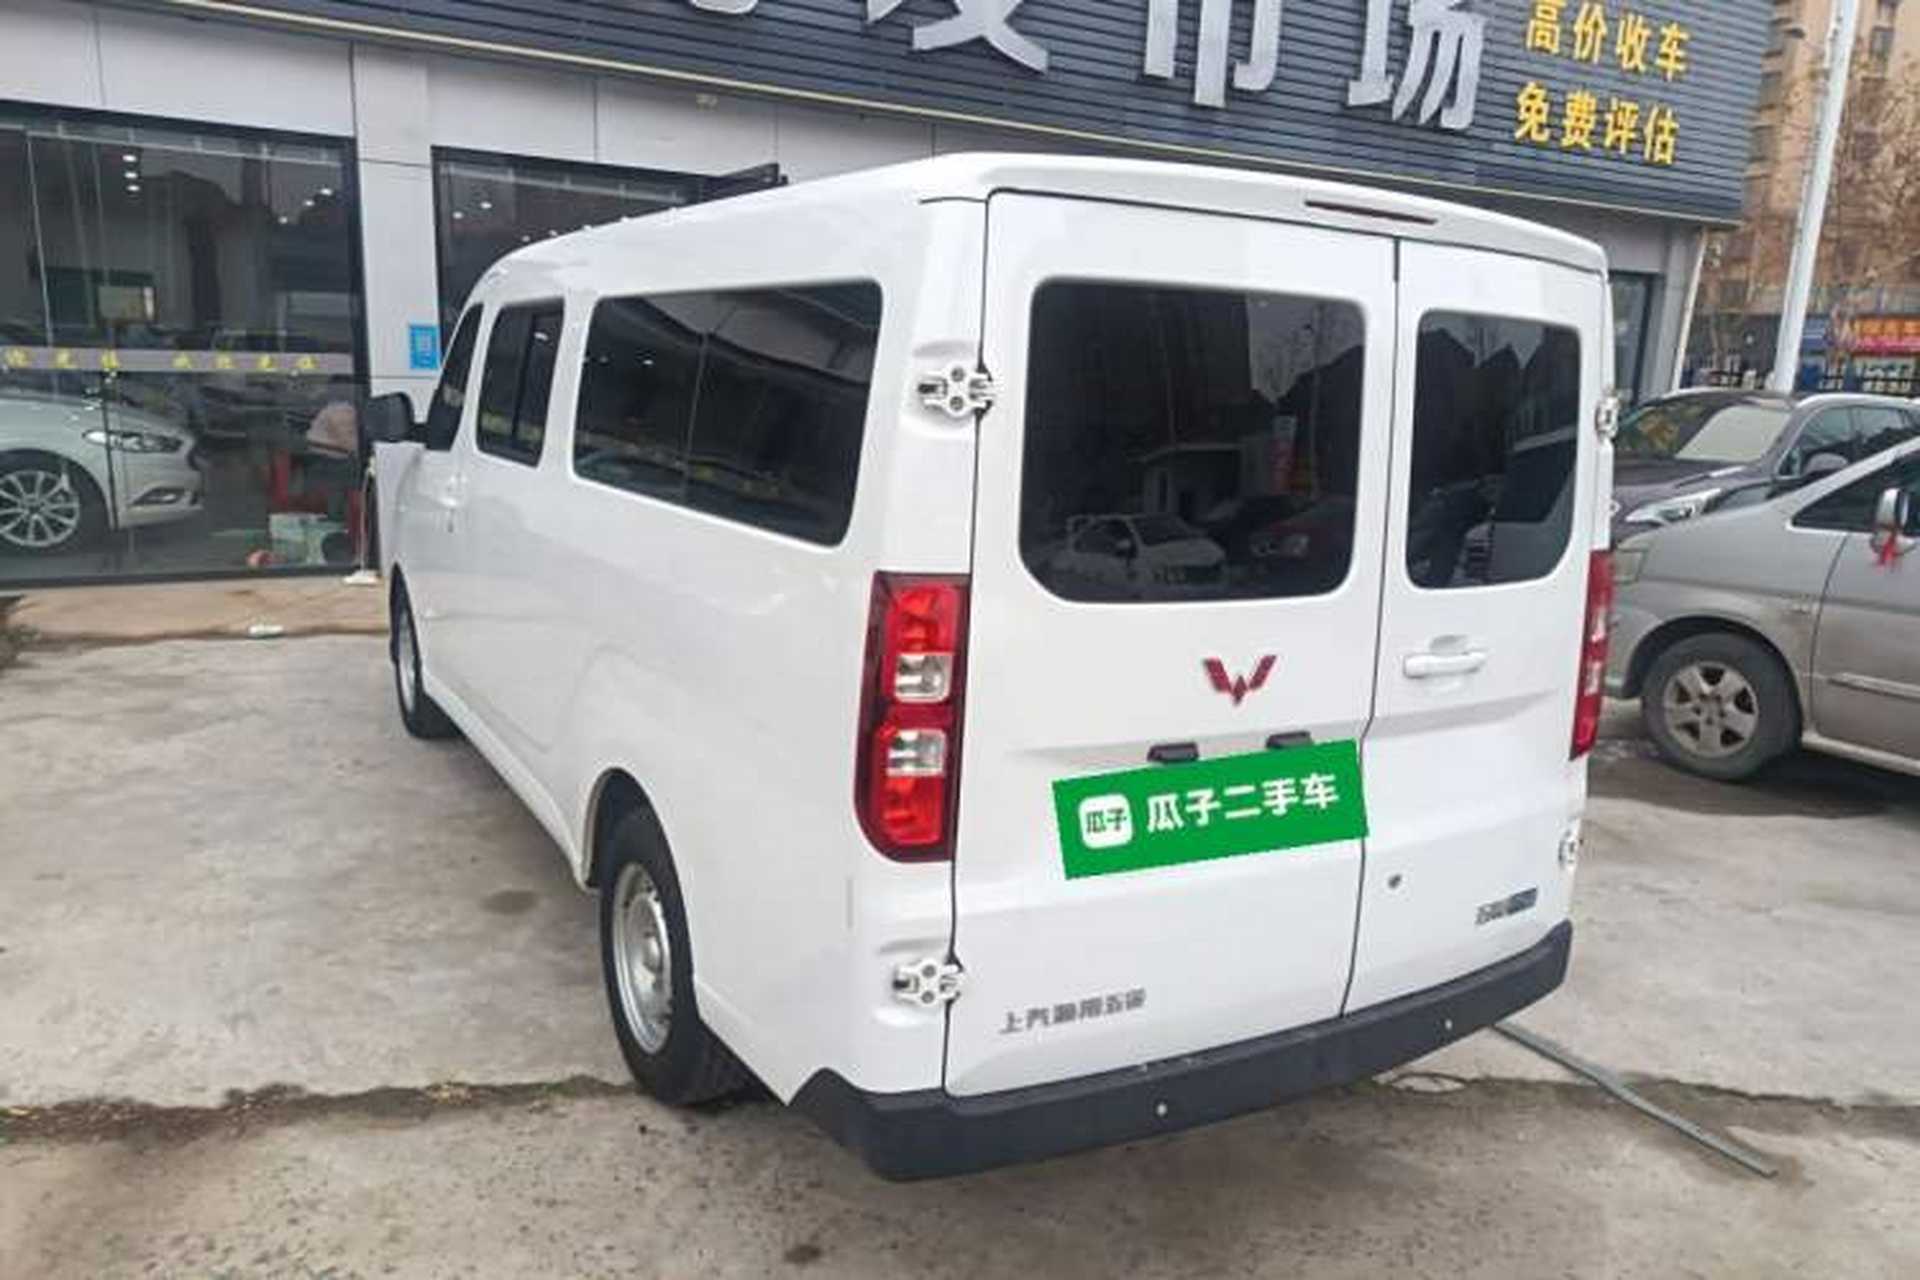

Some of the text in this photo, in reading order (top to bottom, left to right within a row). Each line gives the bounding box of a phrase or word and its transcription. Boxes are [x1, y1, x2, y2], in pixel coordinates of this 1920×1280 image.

[690, 0, 1486, 130] 市场
[1526, 0, 1690, 81] 高价收车
[1514, 81, 1679, 165] 免费评估
